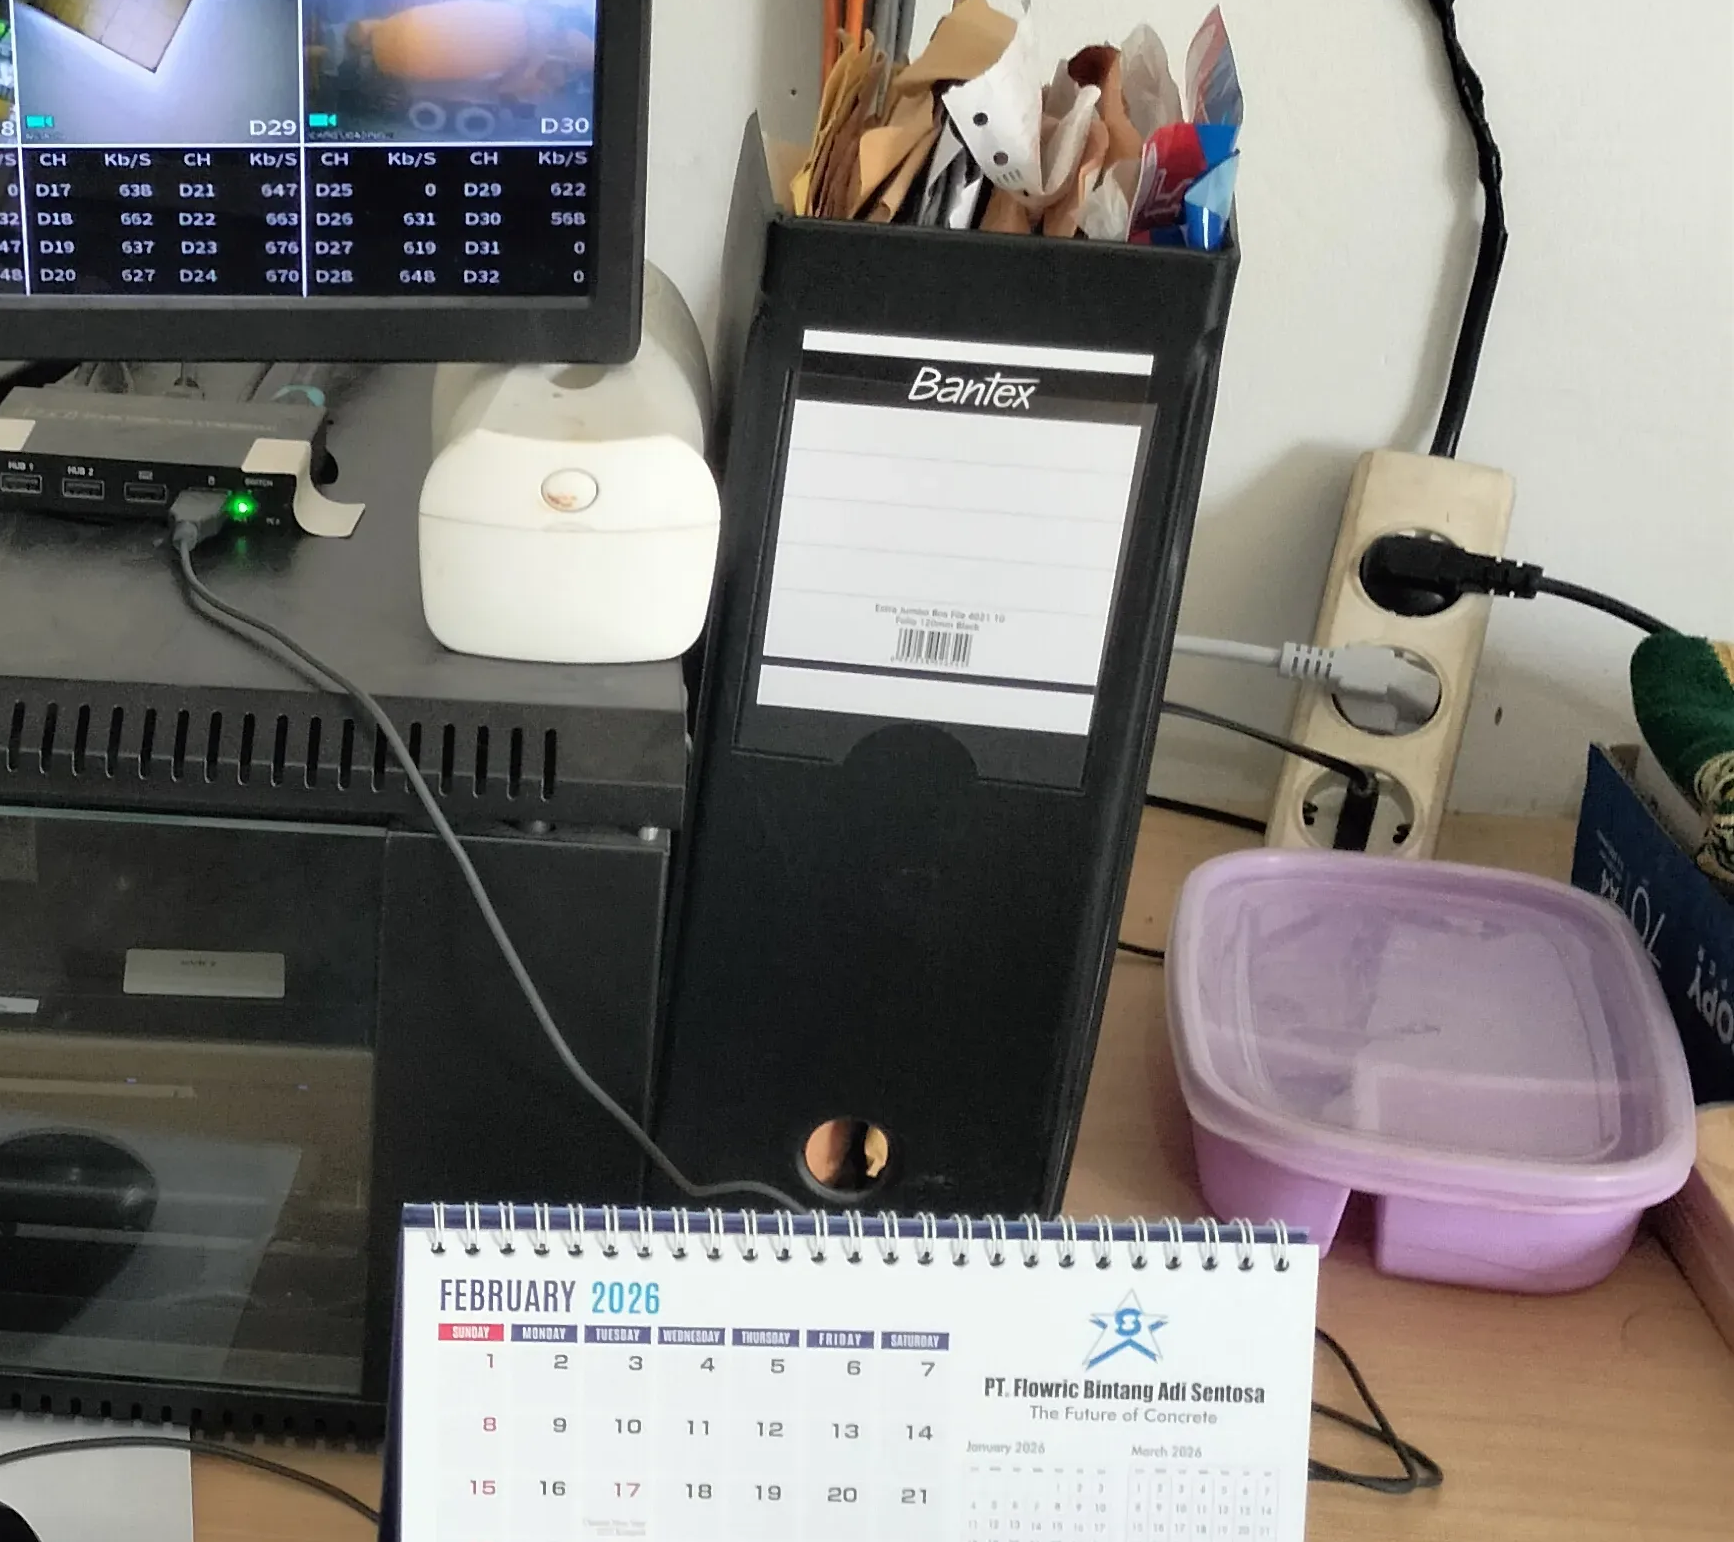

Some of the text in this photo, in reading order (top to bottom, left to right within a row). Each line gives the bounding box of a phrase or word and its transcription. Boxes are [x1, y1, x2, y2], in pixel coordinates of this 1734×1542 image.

[250, 120, 296, 135] D29
[542, 118, 589, 133] D30
[908, 367, 1040, 411] Bantex
[441, 1280, 659, 1313] FEBRUARY 2026
[453, 1326, 939, 1348] SUNDAY MONDAY TUESDAY WEDNESDAY THURSDAY FRIDAY SATURDAY
[487, 1354, 935, 1376] 1 2 3 4 5 6 7
[985, 1378, 1264, 1403] PT. Flowric Bintang Adi Sentosa
[1030, 1405, 1217, 1424] The Future of Concrete
[484, 1418, 932, 1440] 8 9 10 11 12 13 14
[967, 1441, 1045, 1455] January 2026
[1132, 1446, 1202, 1458] March 2026
[471, 1480, 926, 1504] 15 16 17 18 19 20 21
